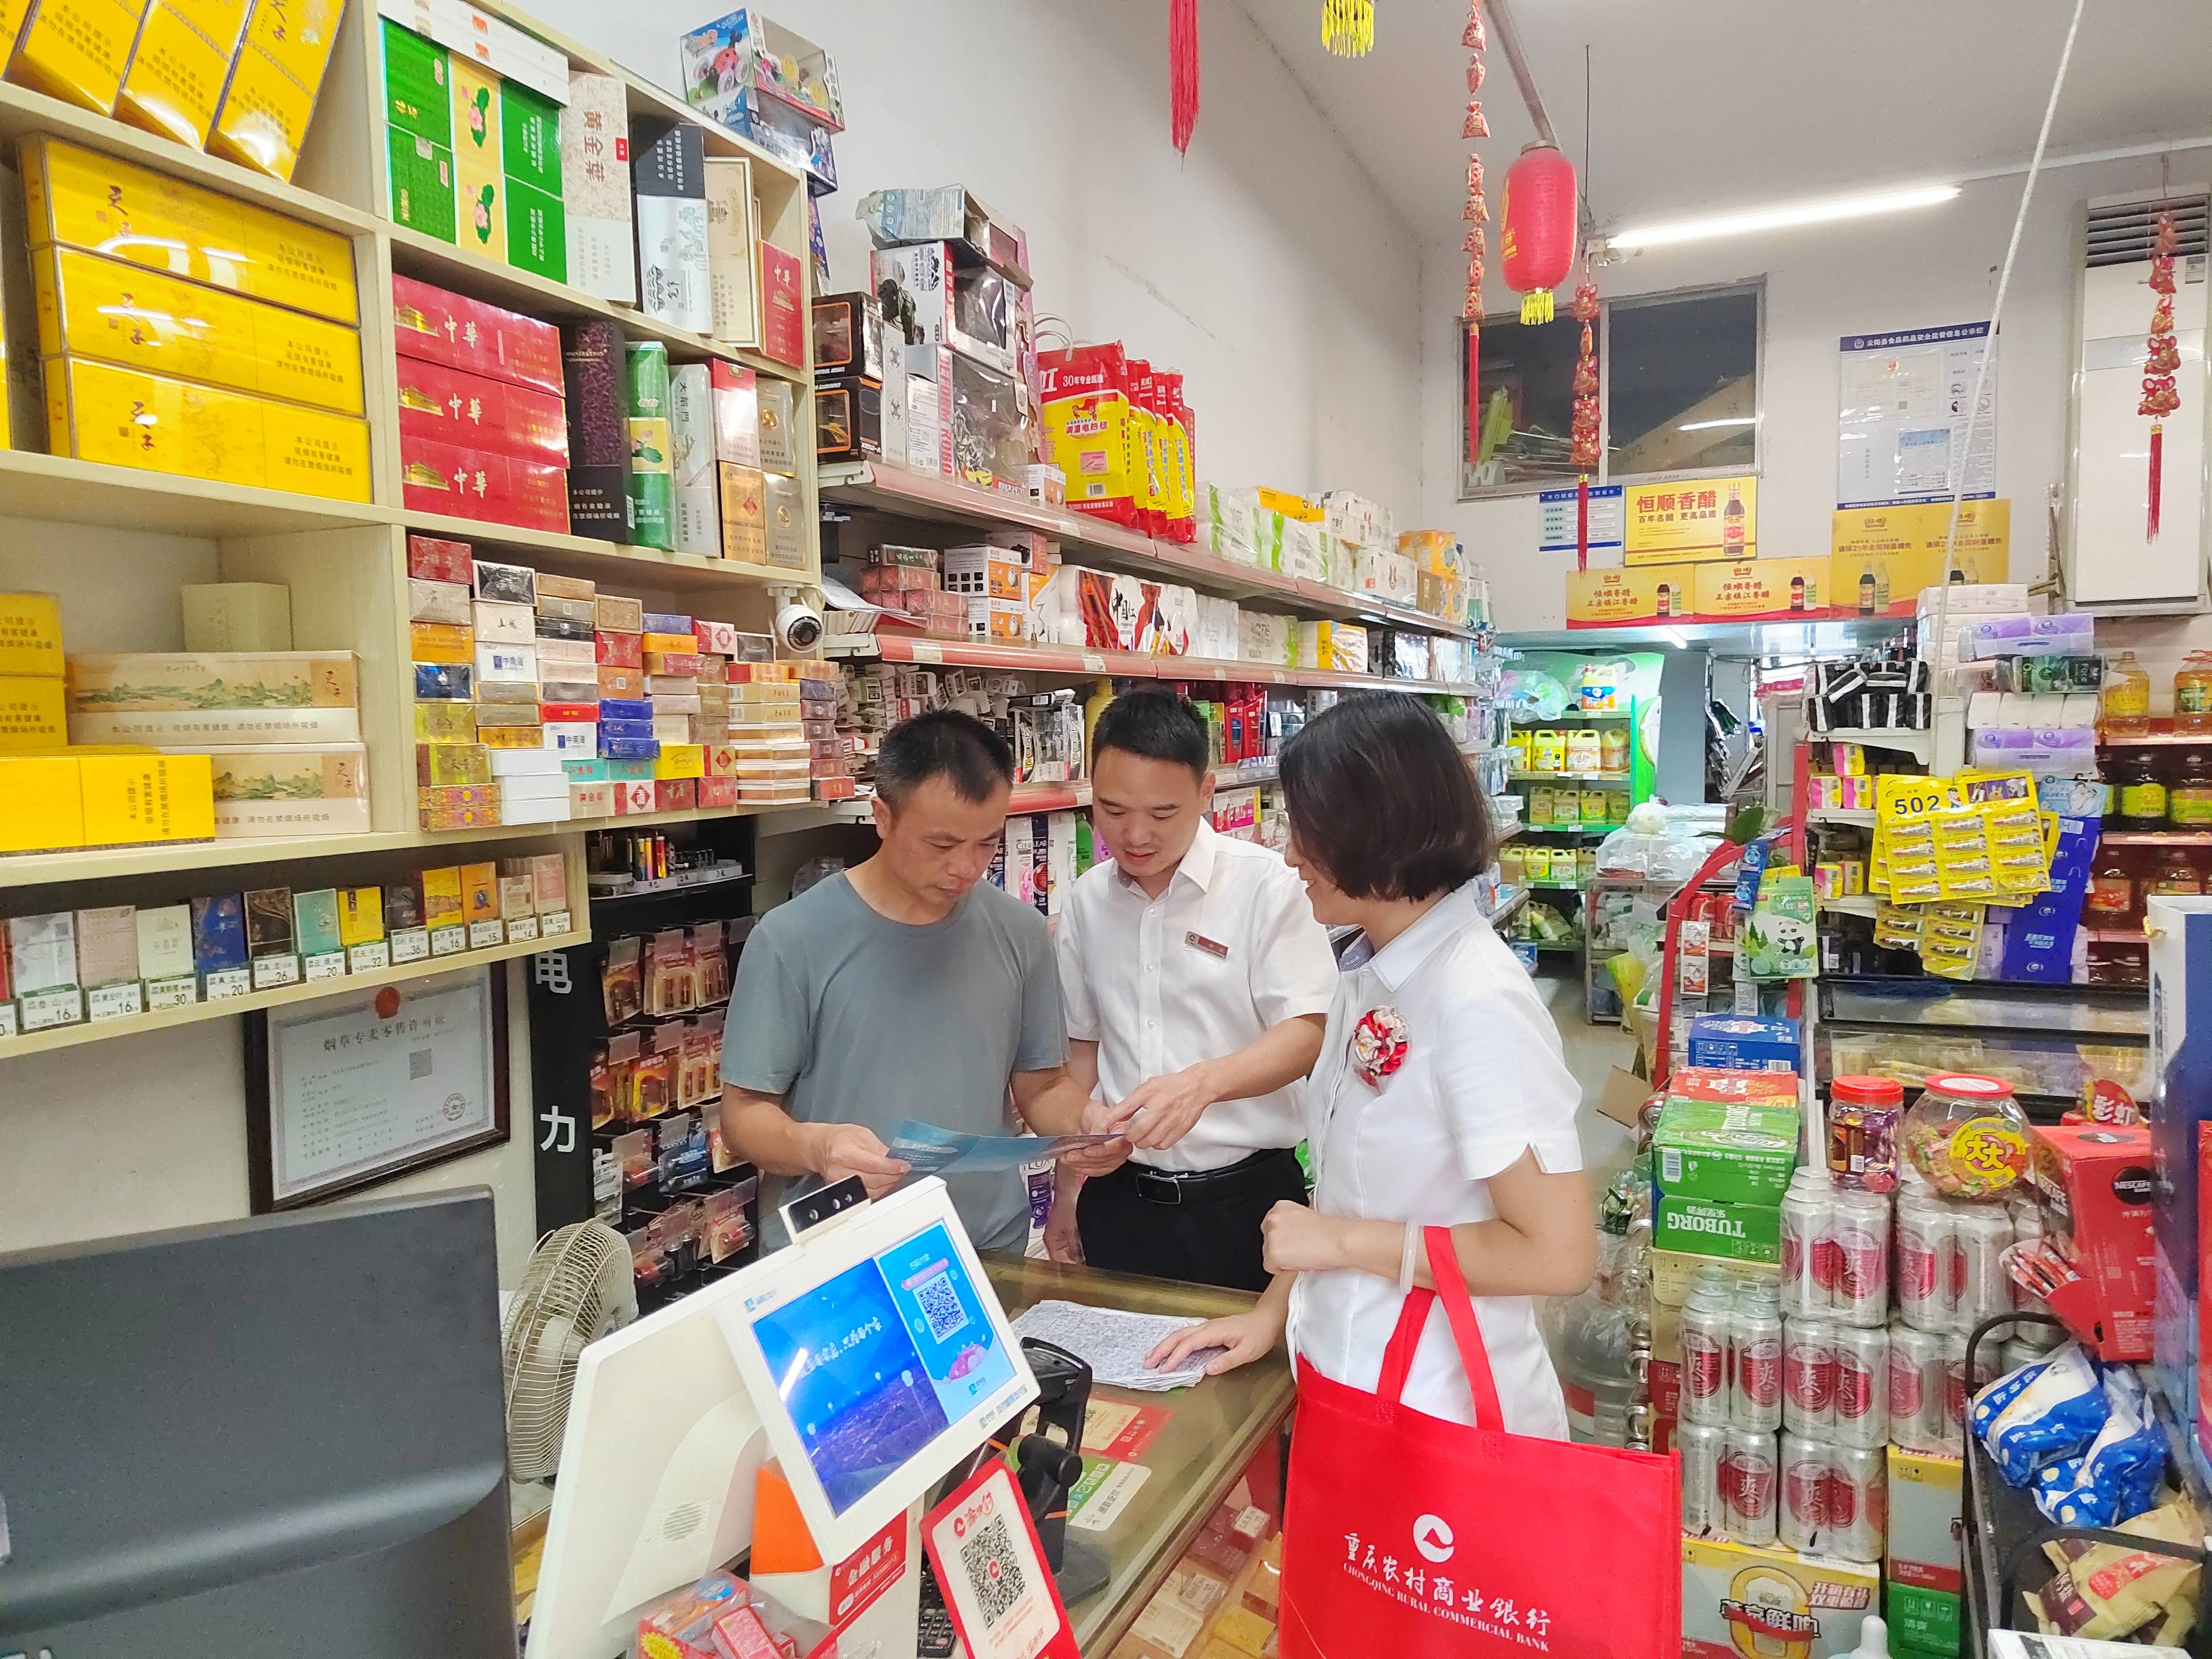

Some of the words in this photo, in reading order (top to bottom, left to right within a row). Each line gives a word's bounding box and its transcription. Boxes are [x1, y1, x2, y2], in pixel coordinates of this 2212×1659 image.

[444, 314, 478, 349] 中華
[939, 354, 951, 424] DEFORM
[448, 393, 483, 426] 中華
[454, 466, 487, 499] 中華
[1637, 490, 1717, 513] 恒顺香醋
[1637, 513, 1674, 523] 百年名醋
[1679, 509, 1716, 521] 更高品质
[1722, 581, 1763, 591] 恒顺香醋
[1593, 589, 1631, 598] 恒顺香醋
[1715, 590, 1771, 601] 正宗镇江香醋
[1112, 588, 1136, 625] 中国红
[1586, 597, 1638, 607] 正宗镇江香醋
[1894, 795, 1941, 815] 502
[488, 932, 497, 942] 15
[411, 945, 422, 955] 36
[450, 939, 460, 949] 16
[372, 956, 382, 968] 32
[275, 972, 288, 982] 26
[326, 967, 337, 977] 20
[231, 985, 244, 996] 20
[174, 994, 186, 1006] 30
[118, 1001, 133, 1014] 16
[56, 1009, 71, 1021] 16
[324, 1014, 445, 1050] 烟草专卖零售许可证
[2094, 1095, 2135, 1125] 彩虹
[1667, 1211, 1746, 1239] TUBORG
[1739, 1475, 1760, 1504] 爽
[1344, 1533, 1551, 1636] 重庆农村商业银行
[1343, 1562, 1394, 1597] CHONGQING
[1397, 1590, 1431, 1614] RURAL
[1433, 1606, 1513, 1641] COMMERCIAL
[1517, 1632, 1549, 1652] BANK
